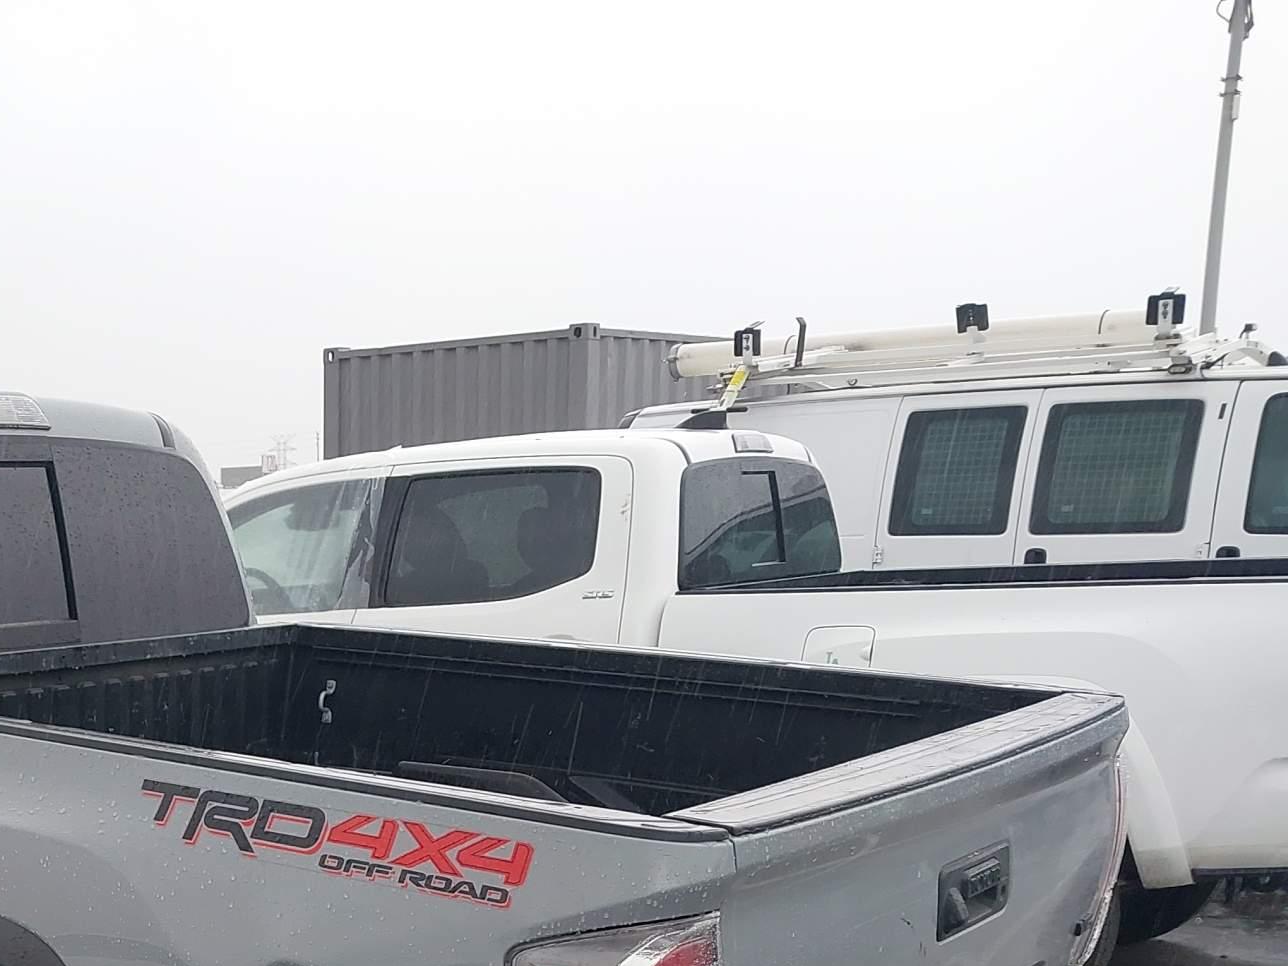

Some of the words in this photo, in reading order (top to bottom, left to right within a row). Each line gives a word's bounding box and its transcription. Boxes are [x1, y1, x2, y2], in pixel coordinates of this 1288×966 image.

[141, 779, 330, 858] TRD
[318, 853, 396, 882] OFF
[396, 868, 514, 908] ROAD
